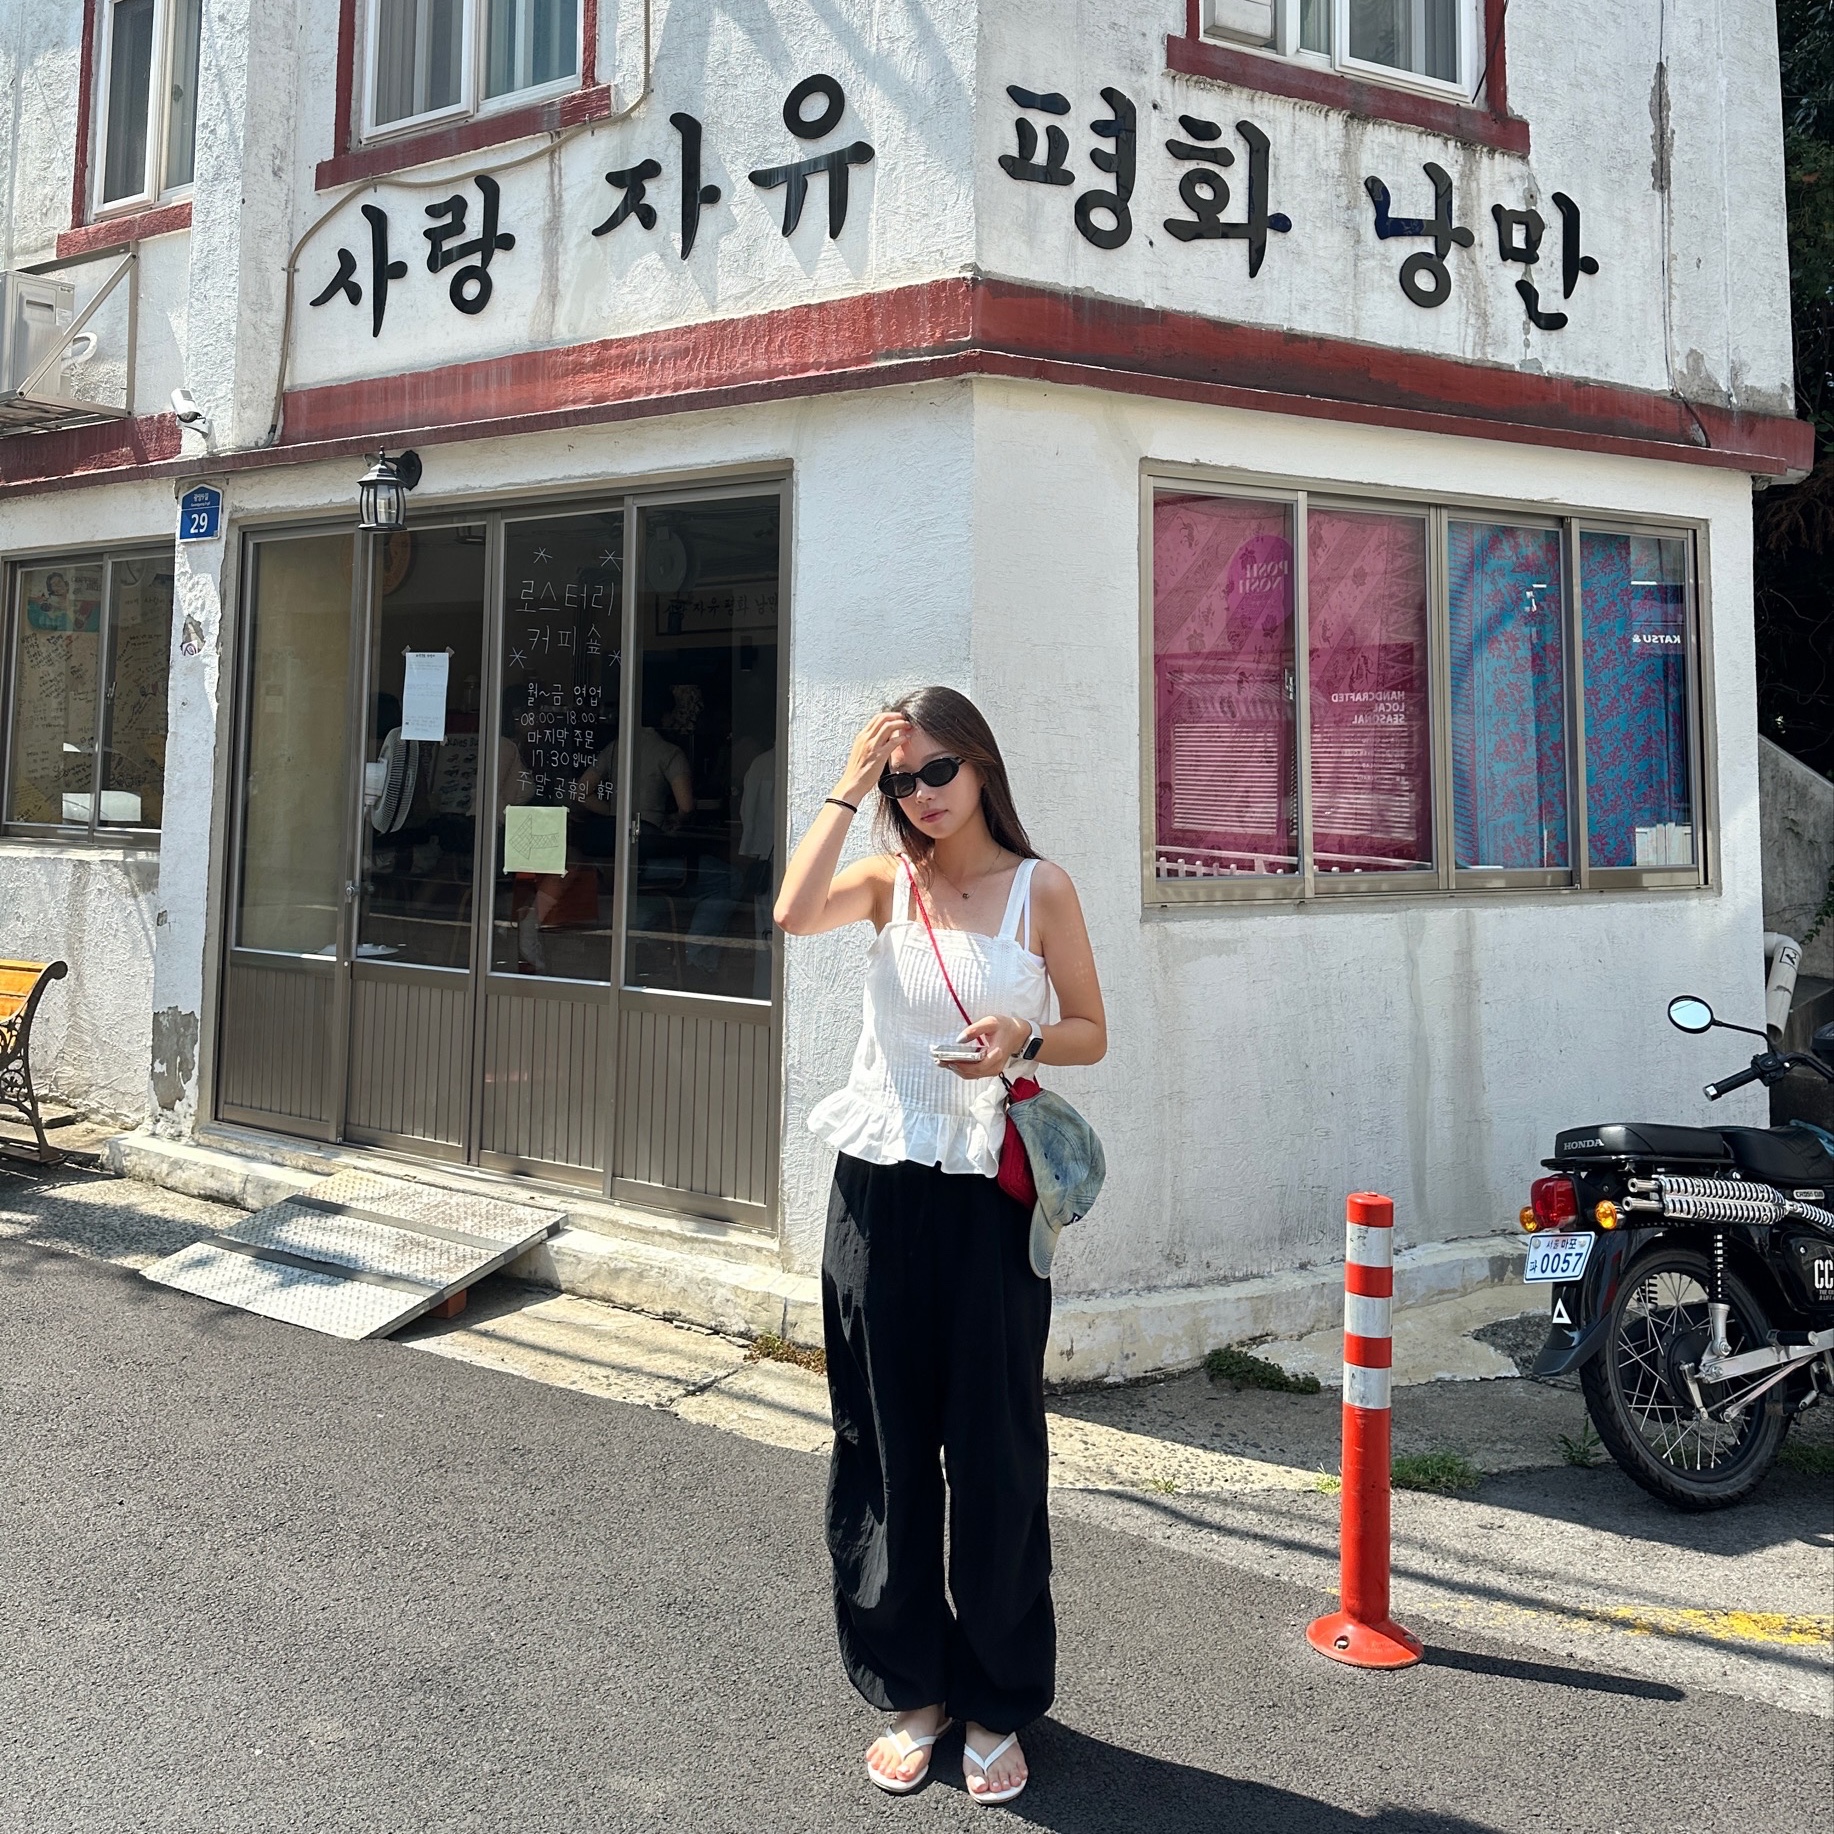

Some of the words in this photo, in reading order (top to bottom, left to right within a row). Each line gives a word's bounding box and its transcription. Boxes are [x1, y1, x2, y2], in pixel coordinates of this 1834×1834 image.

[309, 174, 516, 339] 사랑
[591, 73, 876, 261] 자유
[998, 84, 1293, 279] 평화
[1363, 161, 1600, 331] 낭만
[190, 512, 208, 534] 29
[515, 580, 615, 617] 로스터리
[573, 684, 602, 707] 영업
[527, 728, 570, 748] 마지막
[573, 729, 595, 749] 주문
[532, 749, 570, 768] 17:30
[597, 780, 614, 801] 휴무
[1563, 1138, 1605, 1150] HONDA
[1545, 1239, 1560, 1250] 서울
[1560, 1238, 1577, 1250] 마포
[1540, 1252, 1584, 1274] 0057
